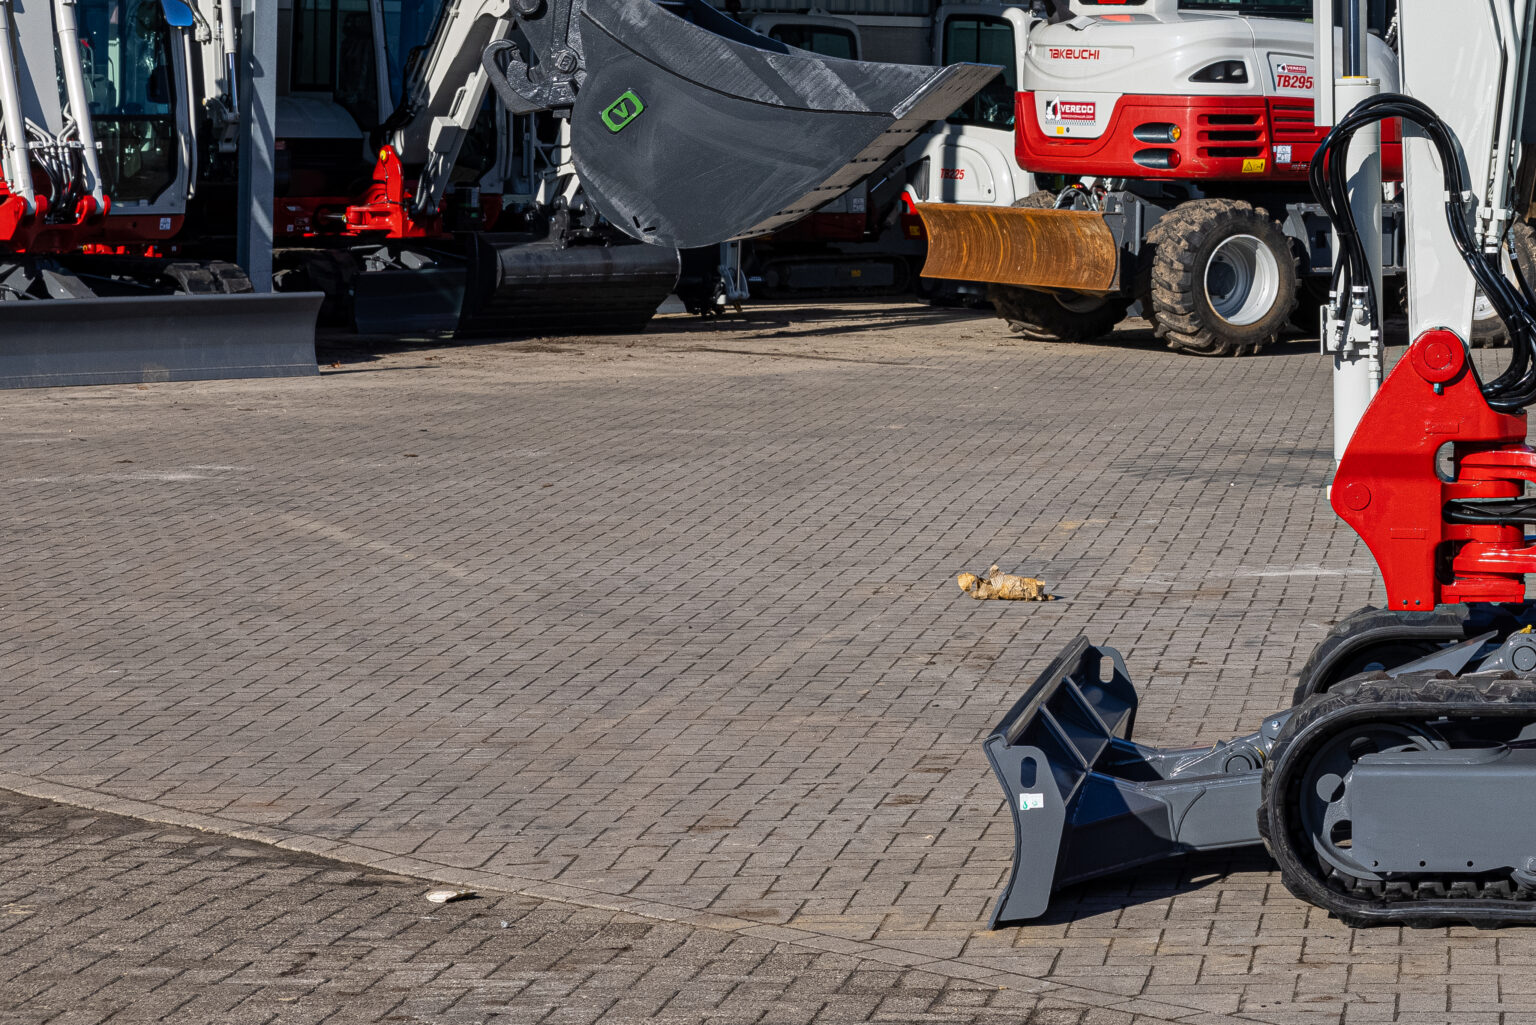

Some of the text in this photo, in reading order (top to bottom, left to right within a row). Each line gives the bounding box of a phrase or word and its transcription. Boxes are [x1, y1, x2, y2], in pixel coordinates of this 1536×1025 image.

[1048, 48, 1100, 61] TAKEUCHI
[1276, 74, 1315, 90] TB295
[1060, 104, 1094, 114] VERECO
[940, 167, 966, 181] TB225
